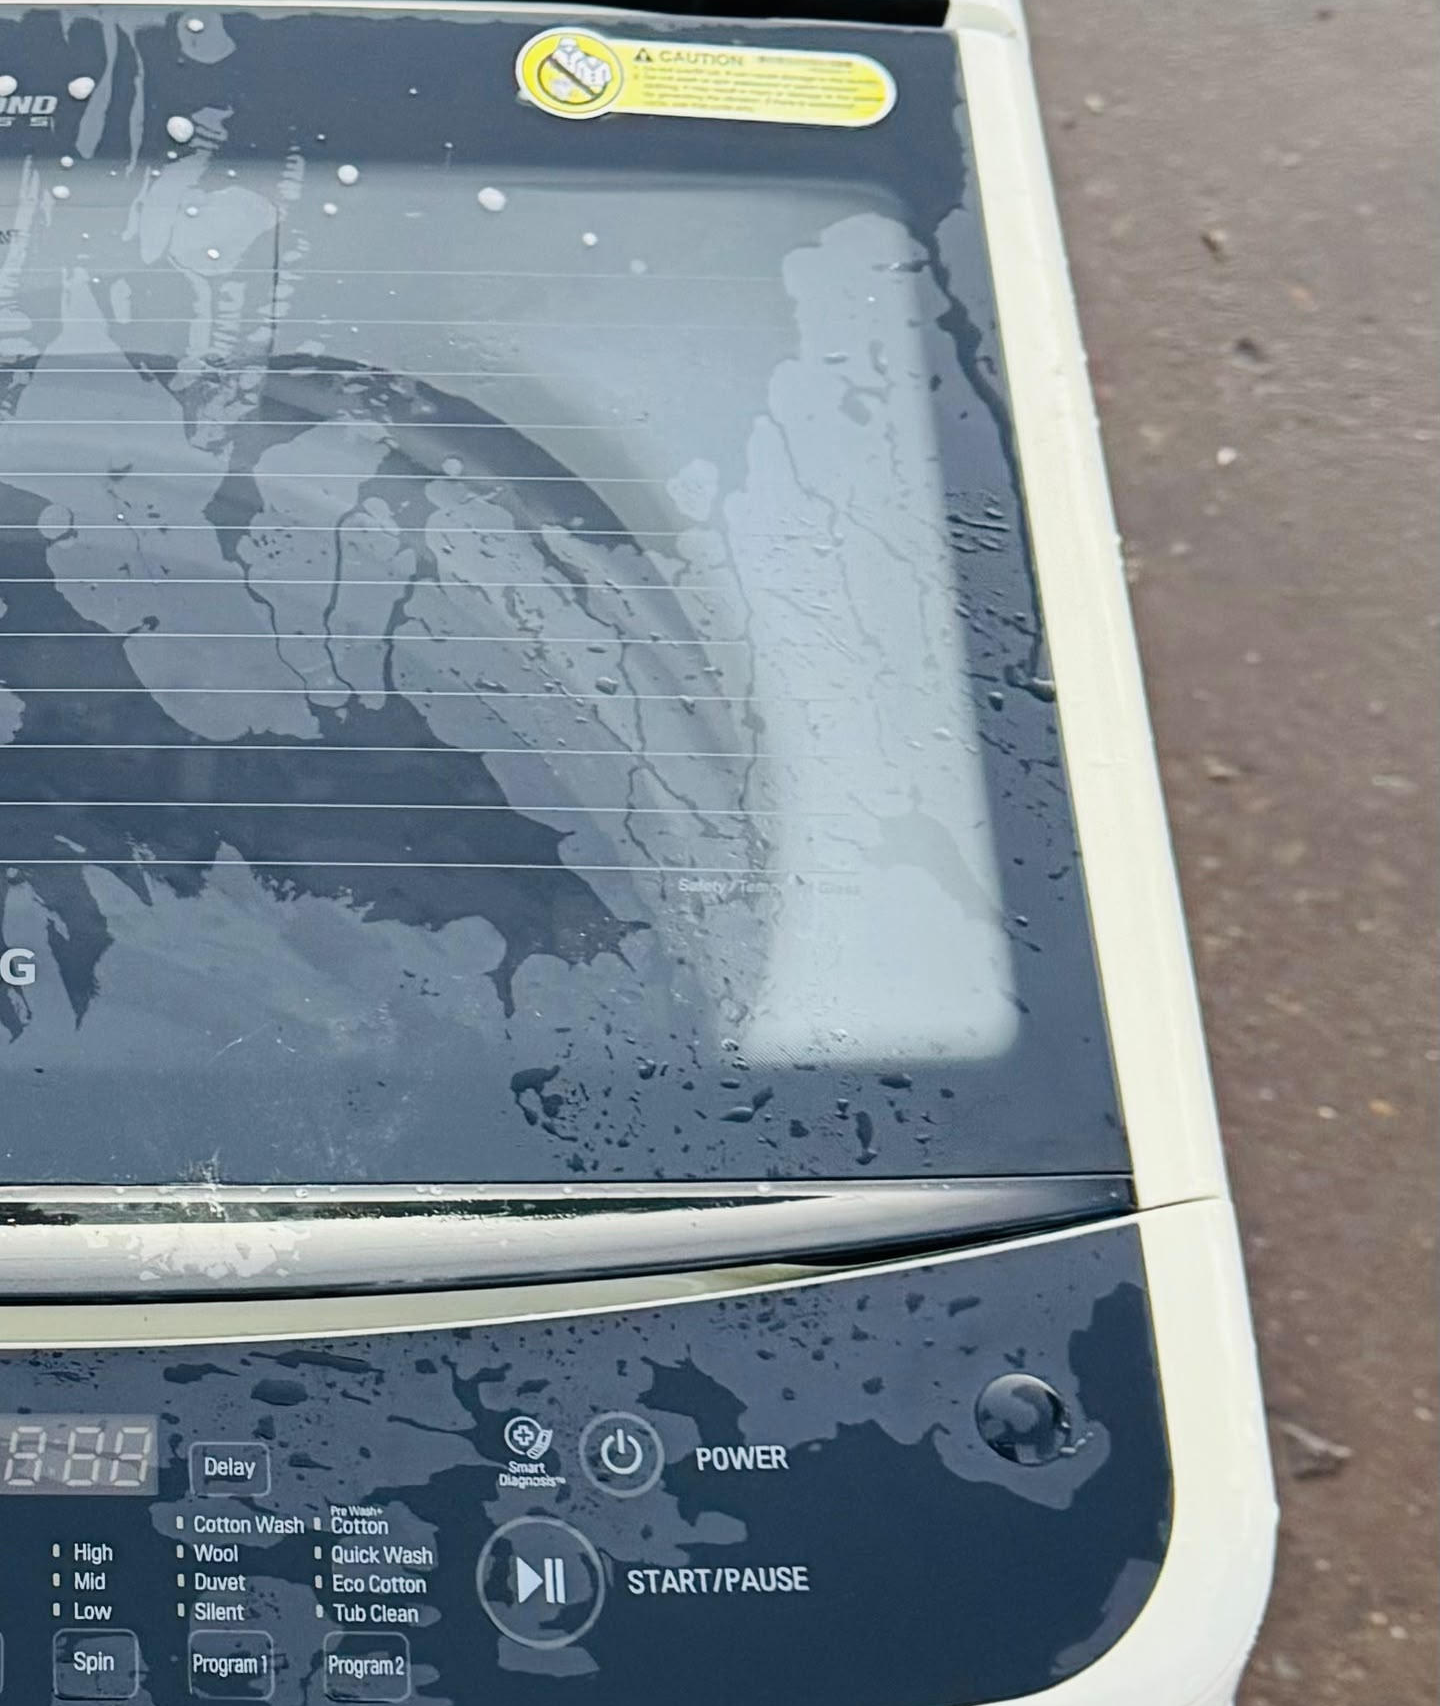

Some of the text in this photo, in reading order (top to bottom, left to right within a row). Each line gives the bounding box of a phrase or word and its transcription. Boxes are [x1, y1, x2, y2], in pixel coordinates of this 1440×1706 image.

[659, 49, 744, 67] CAUTION
[696, 1445, 790, 1471] POWER
[204, 1458, 257, 1480] Delay
[508, 1461, 546, 1475] Smart
[330, 1505, 347, 1516] Pre
[193, 1515, 305, 1534] Cotton Wash
[331, 1516, 389, 1535] Cotton
[74, 1543, 113, 1565] High
[194, 1544, 239, 1563] Wool
[331, 1546, 433, 1565] Quick Wash
[74, 1572, 106, 1591] Mid
[194, 1573, 247, 1592] Duvet
[332, 1574, 427, 1594] Eco Cotton
[627, 1566, 810, 1594] START/PAUSE
[74, 1602, 113, 1621] Low
[194, 1602, 245, 1621] Silent
[333, 1603, 419, 1623] Tub Clean
[73, 1651, 115, 1675] Spin
[193, 1654, 268, 1677] Program 1
[328, 1655, 405, 1678] Program 2
